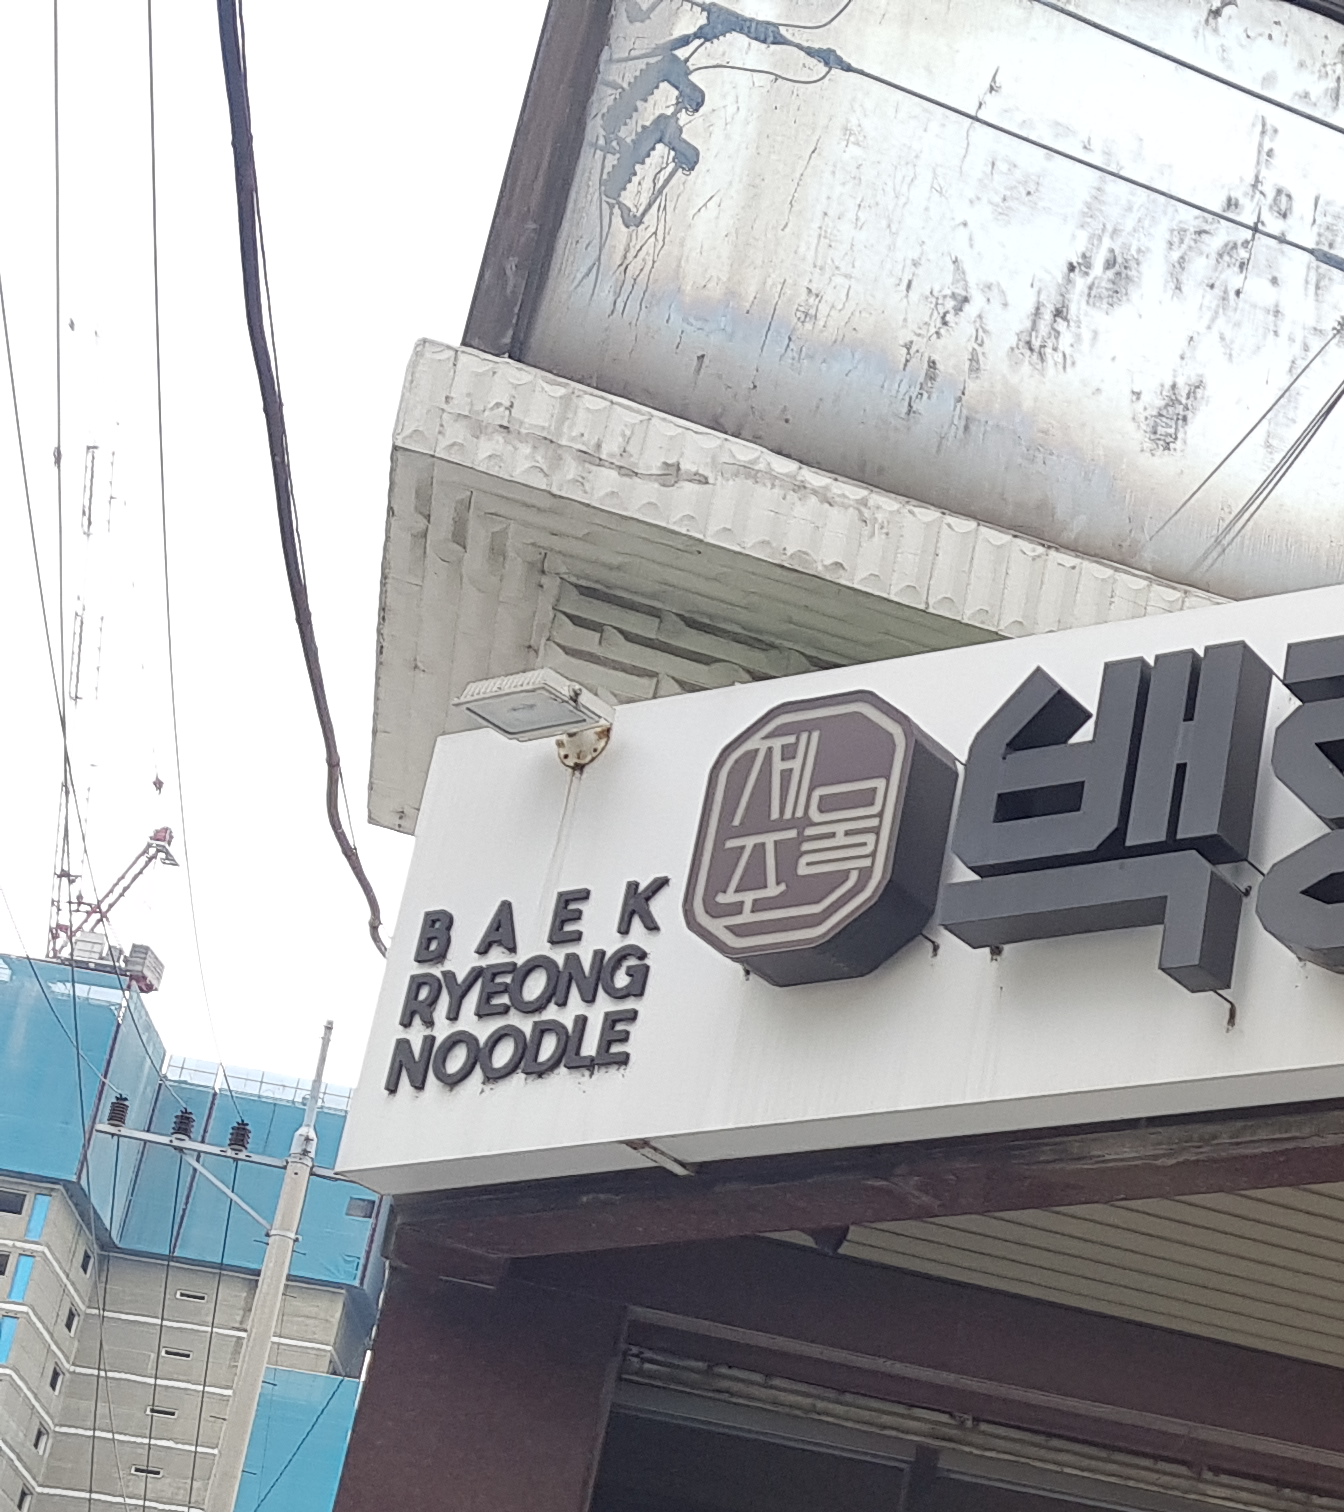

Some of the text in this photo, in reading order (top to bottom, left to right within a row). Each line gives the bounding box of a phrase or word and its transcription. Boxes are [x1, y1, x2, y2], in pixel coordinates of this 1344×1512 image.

[414, 875, 672, 963] BAEK
[400, 944, 650, 1028] RYEONG
[384, 1008, 640, 1095] NOODLE
